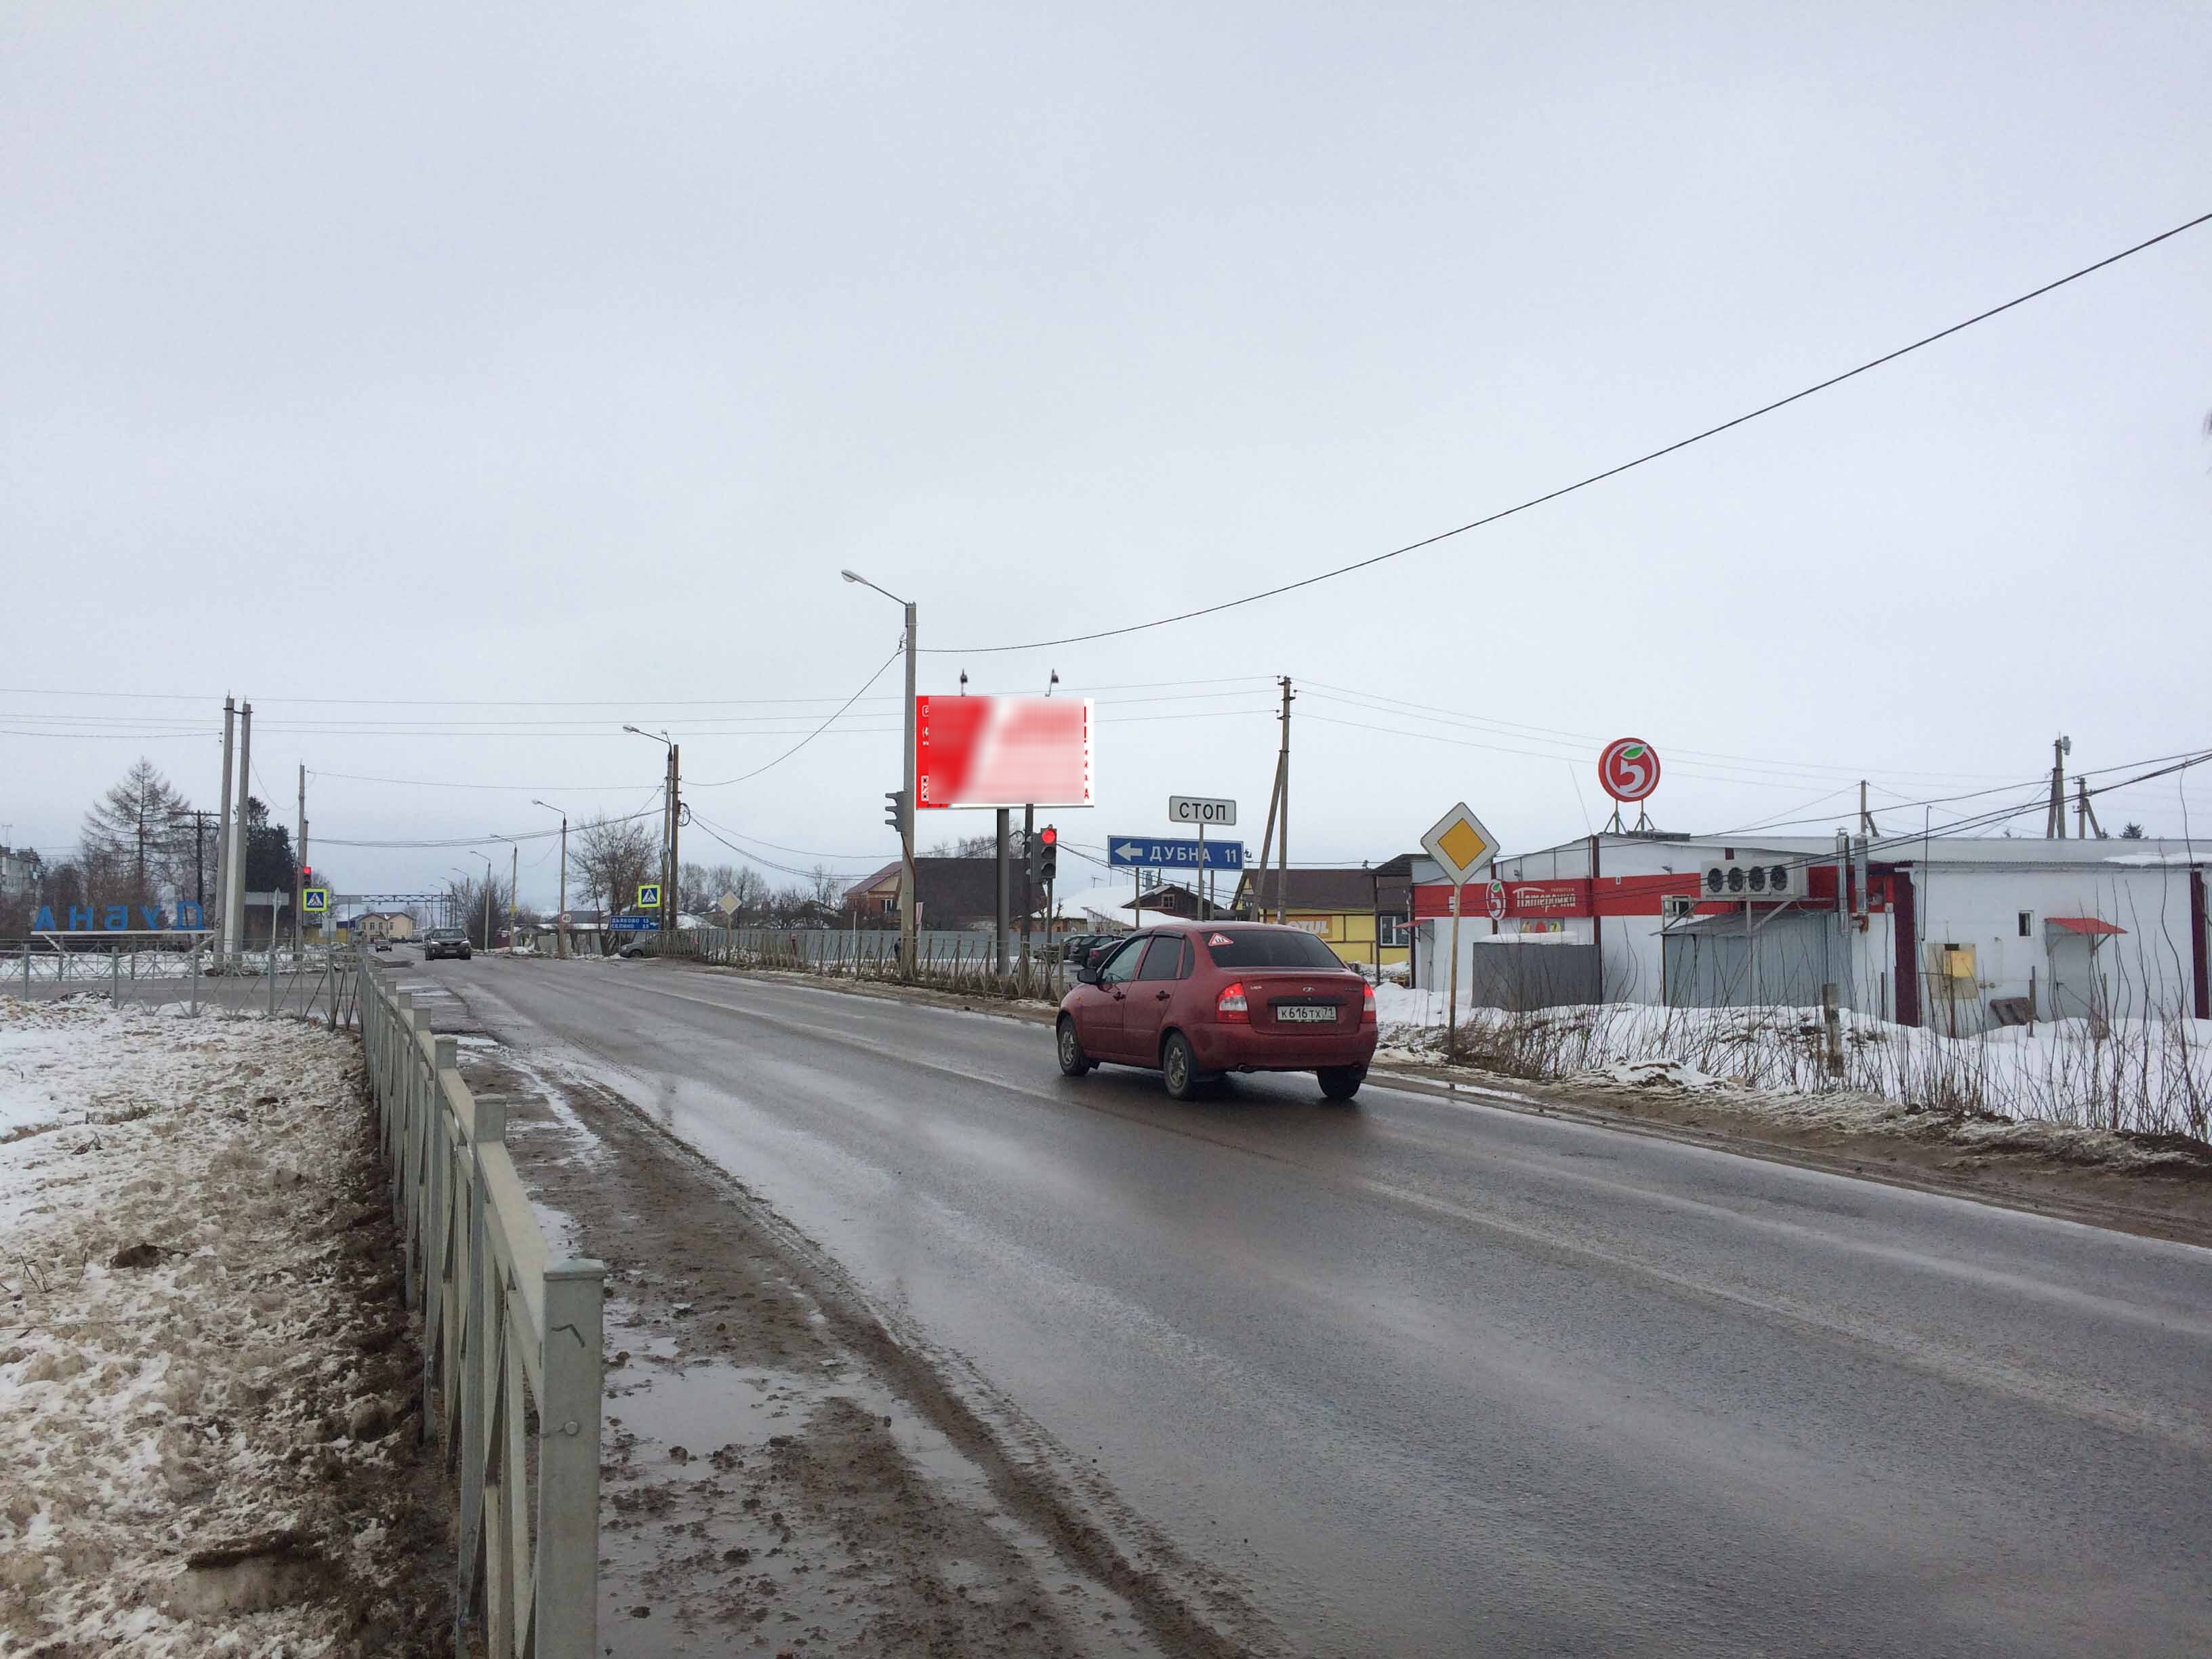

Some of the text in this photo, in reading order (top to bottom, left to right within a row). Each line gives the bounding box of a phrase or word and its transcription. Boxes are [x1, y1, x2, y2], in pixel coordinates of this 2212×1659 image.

[1179, 802, 1226, 821] СТОП
[1149, 845, 1237, 863] ДУБНА 11
[1322, 1007, 1333, 1016] 71
